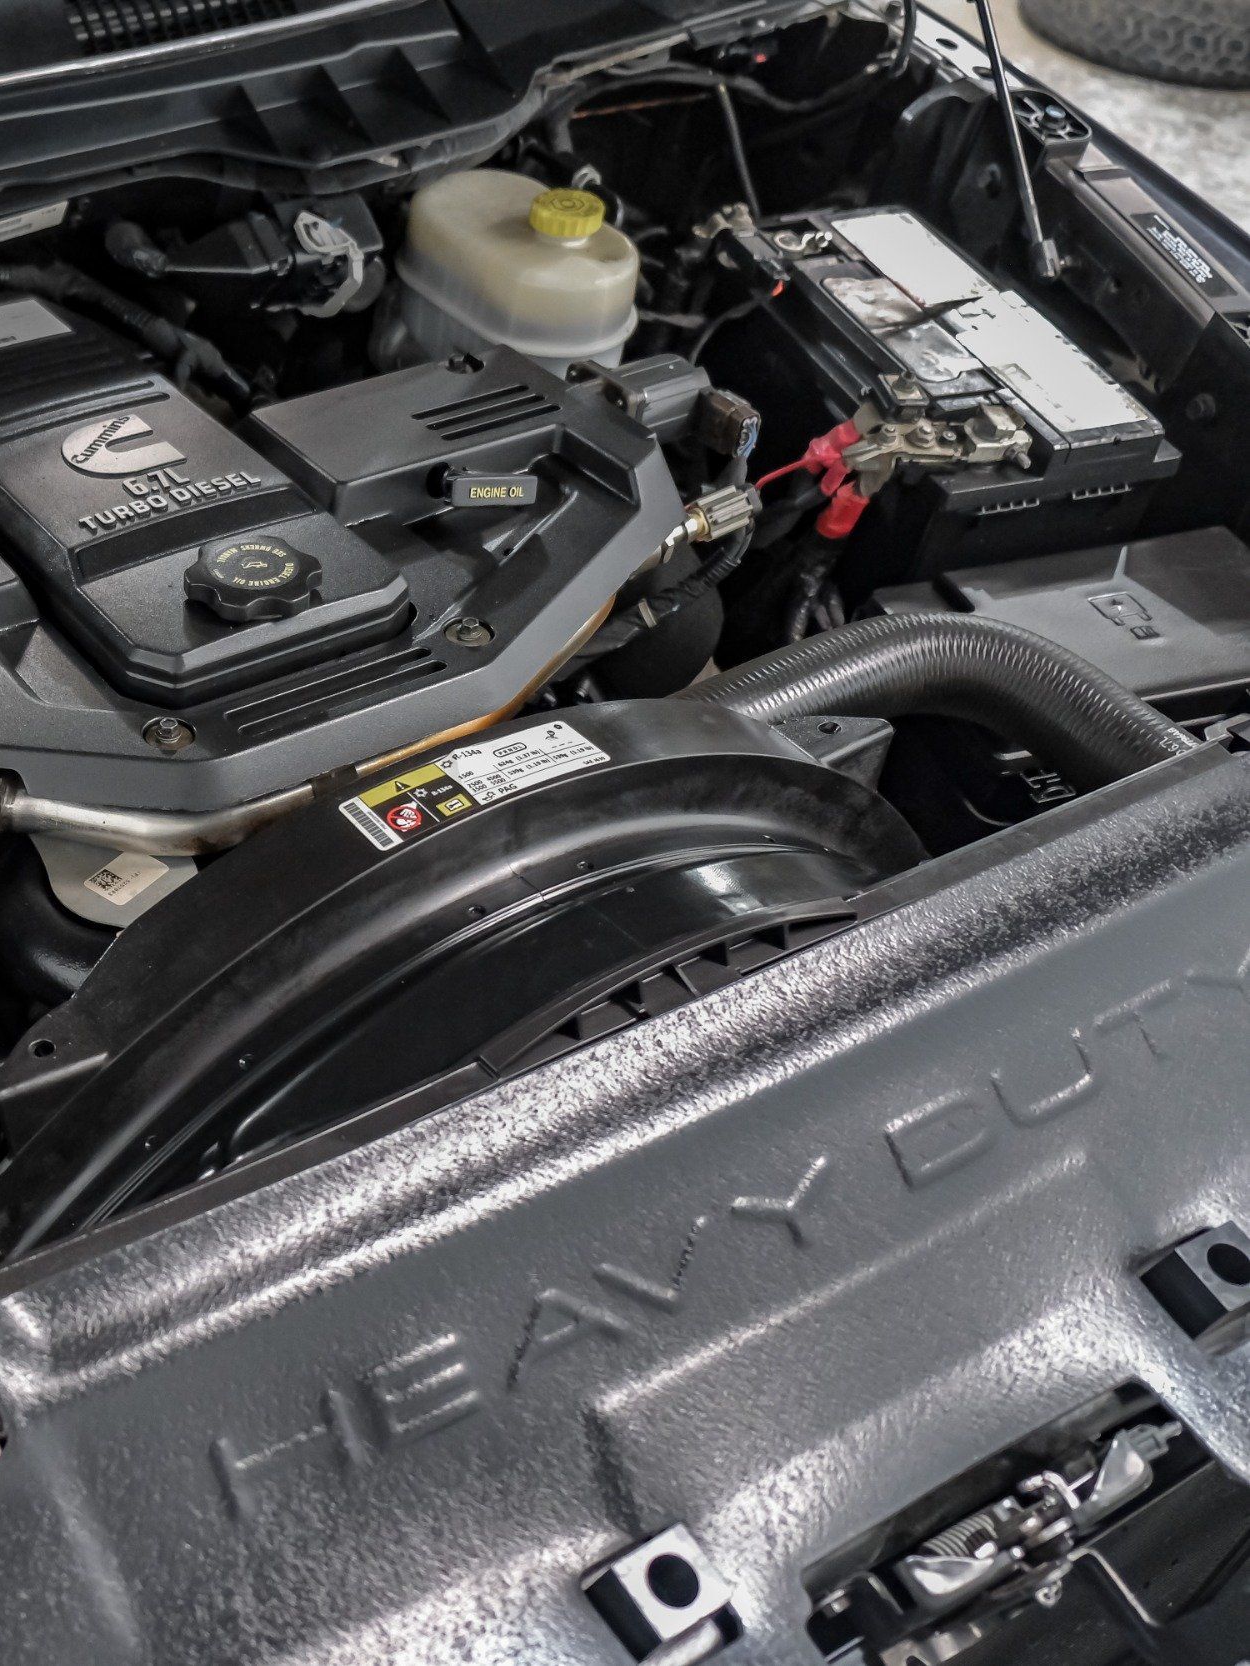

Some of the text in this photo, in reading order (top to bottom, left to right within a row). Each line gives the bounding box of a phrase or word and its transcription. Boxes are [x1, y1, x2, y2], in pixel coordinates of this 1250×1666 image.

[71, 415, 131, 465] Cummins
[122, 468, 191, 498] 6.7L
[469, 486, 524, 499] ENGINE OIL
[79, 471, 262, 536] TURBO DIESEL
[217, 547, 238, 563] MANUAL
[272, 548, 287, 558] SEE
[233, 562, 295, 588] DIESEL ENGINE OIL
[452, 748, 482, 761] R-134a
[498, 784, 518, 794] PAG
[209, 1155, 828, 1522] HEAVY
